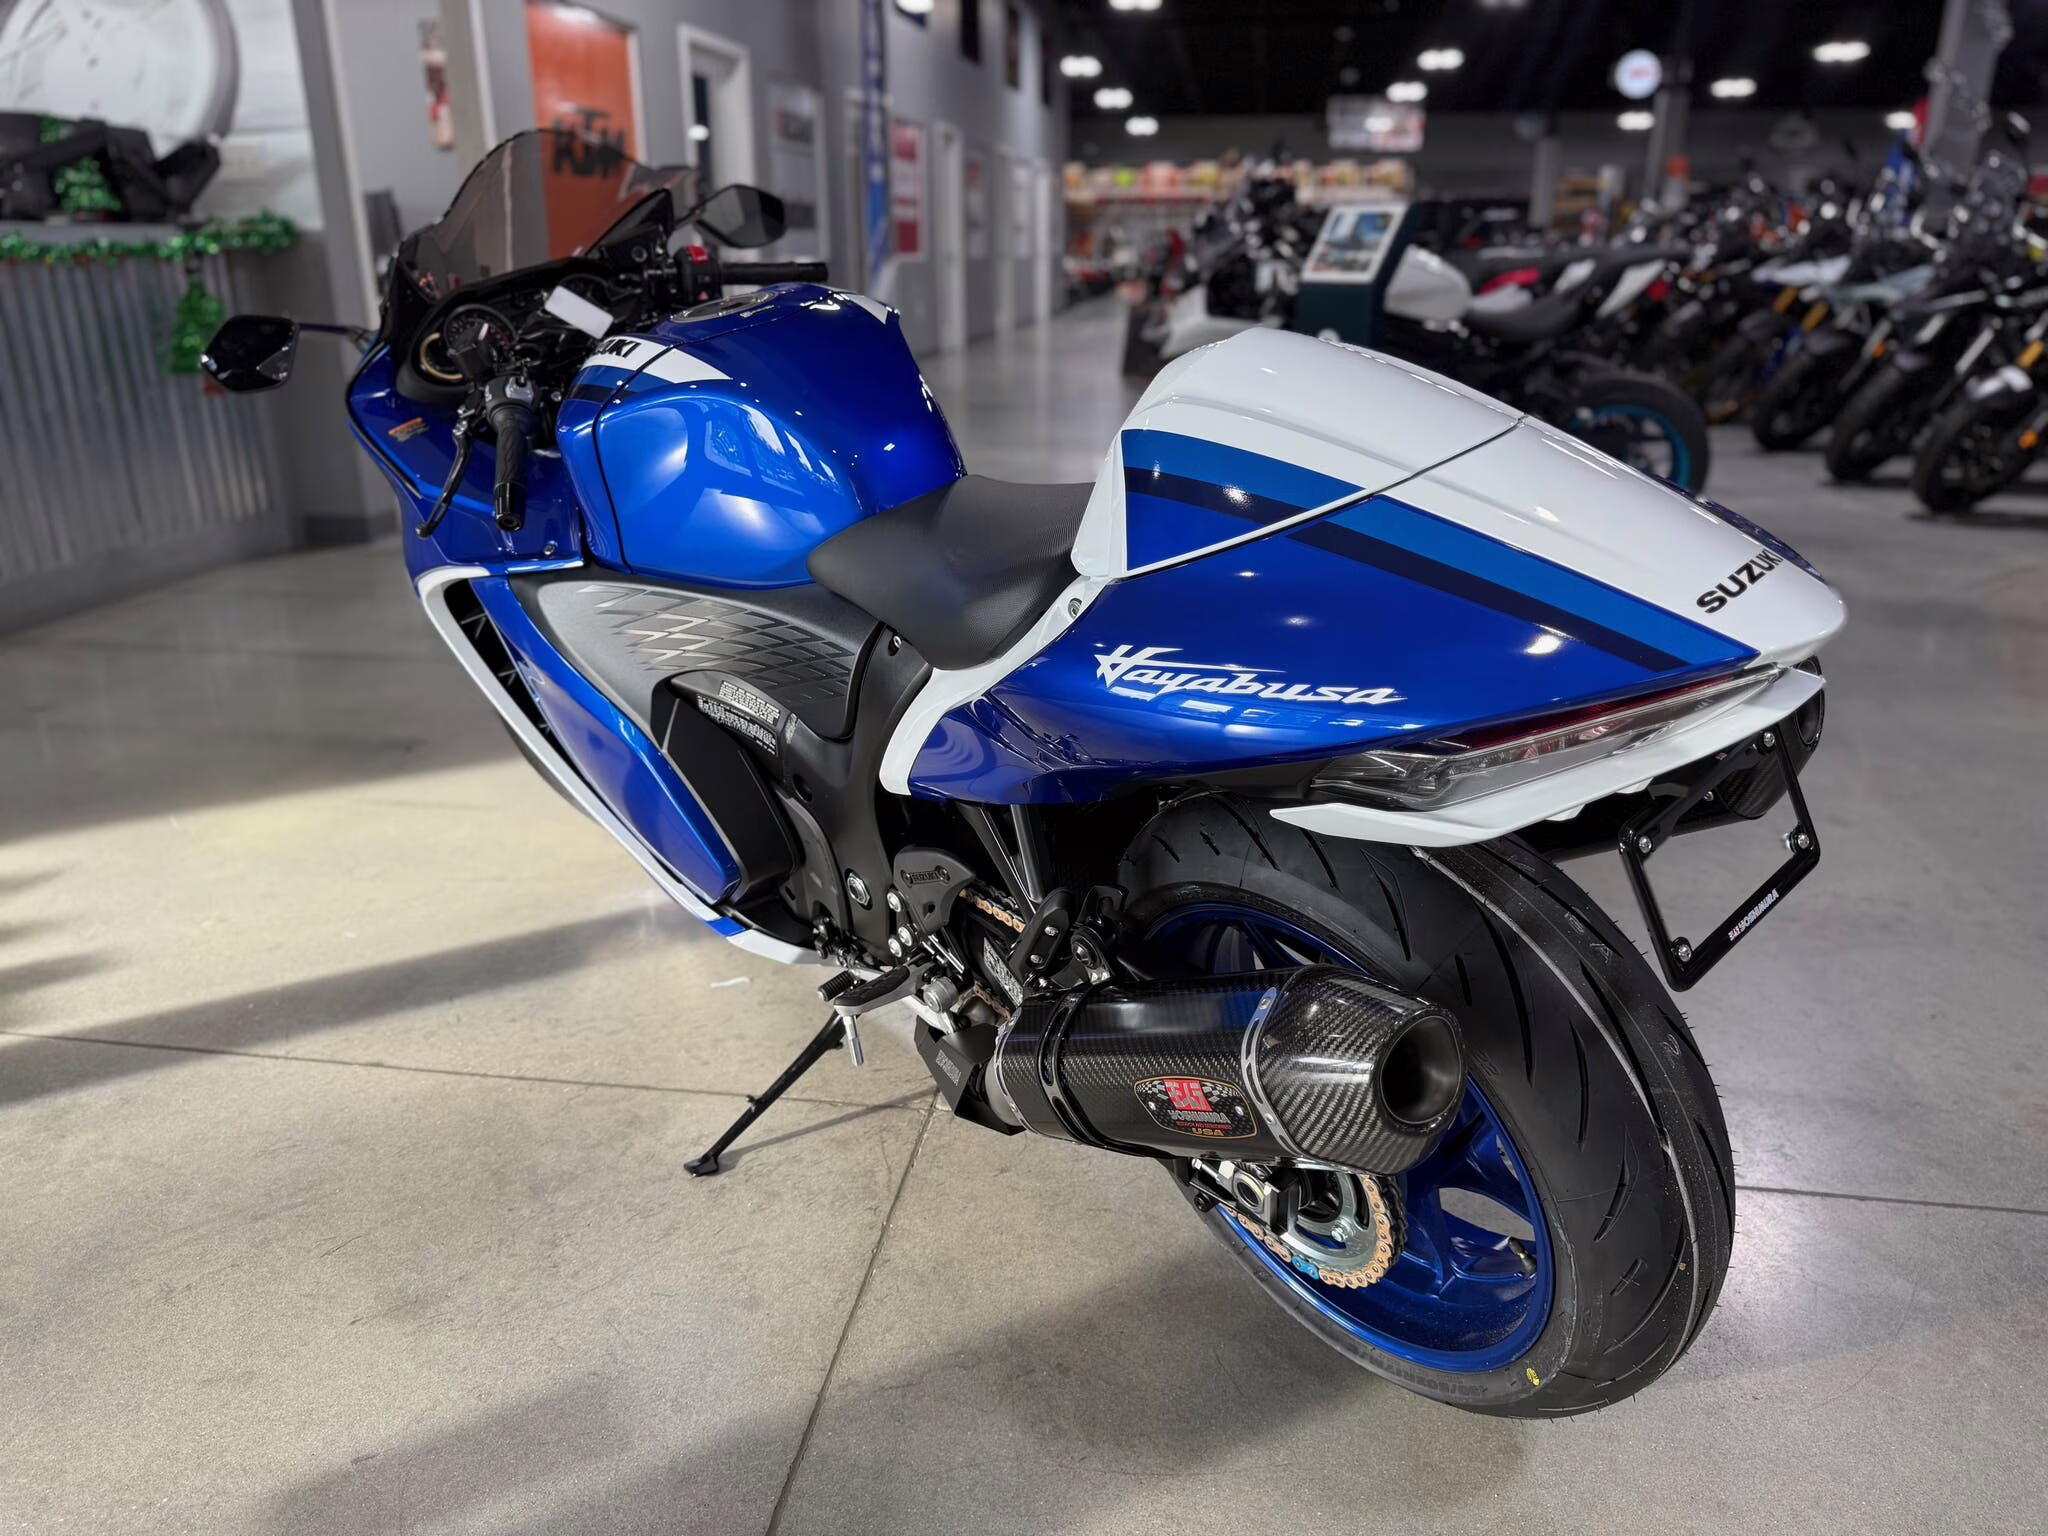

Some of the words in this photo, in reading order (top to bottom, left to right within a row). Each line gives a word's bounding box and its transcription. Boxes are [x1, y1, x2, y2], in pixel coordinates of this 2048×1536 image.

[552, 105, 624, 177] KTM
[1696, 548, 1783, 614] SUZUKI
[1094, 644, 1408, 705] Hayabusa
[1168, 1109, 1231, 1124] YOSHIMURA
[1192, 1127, 1225, 1137] USA
